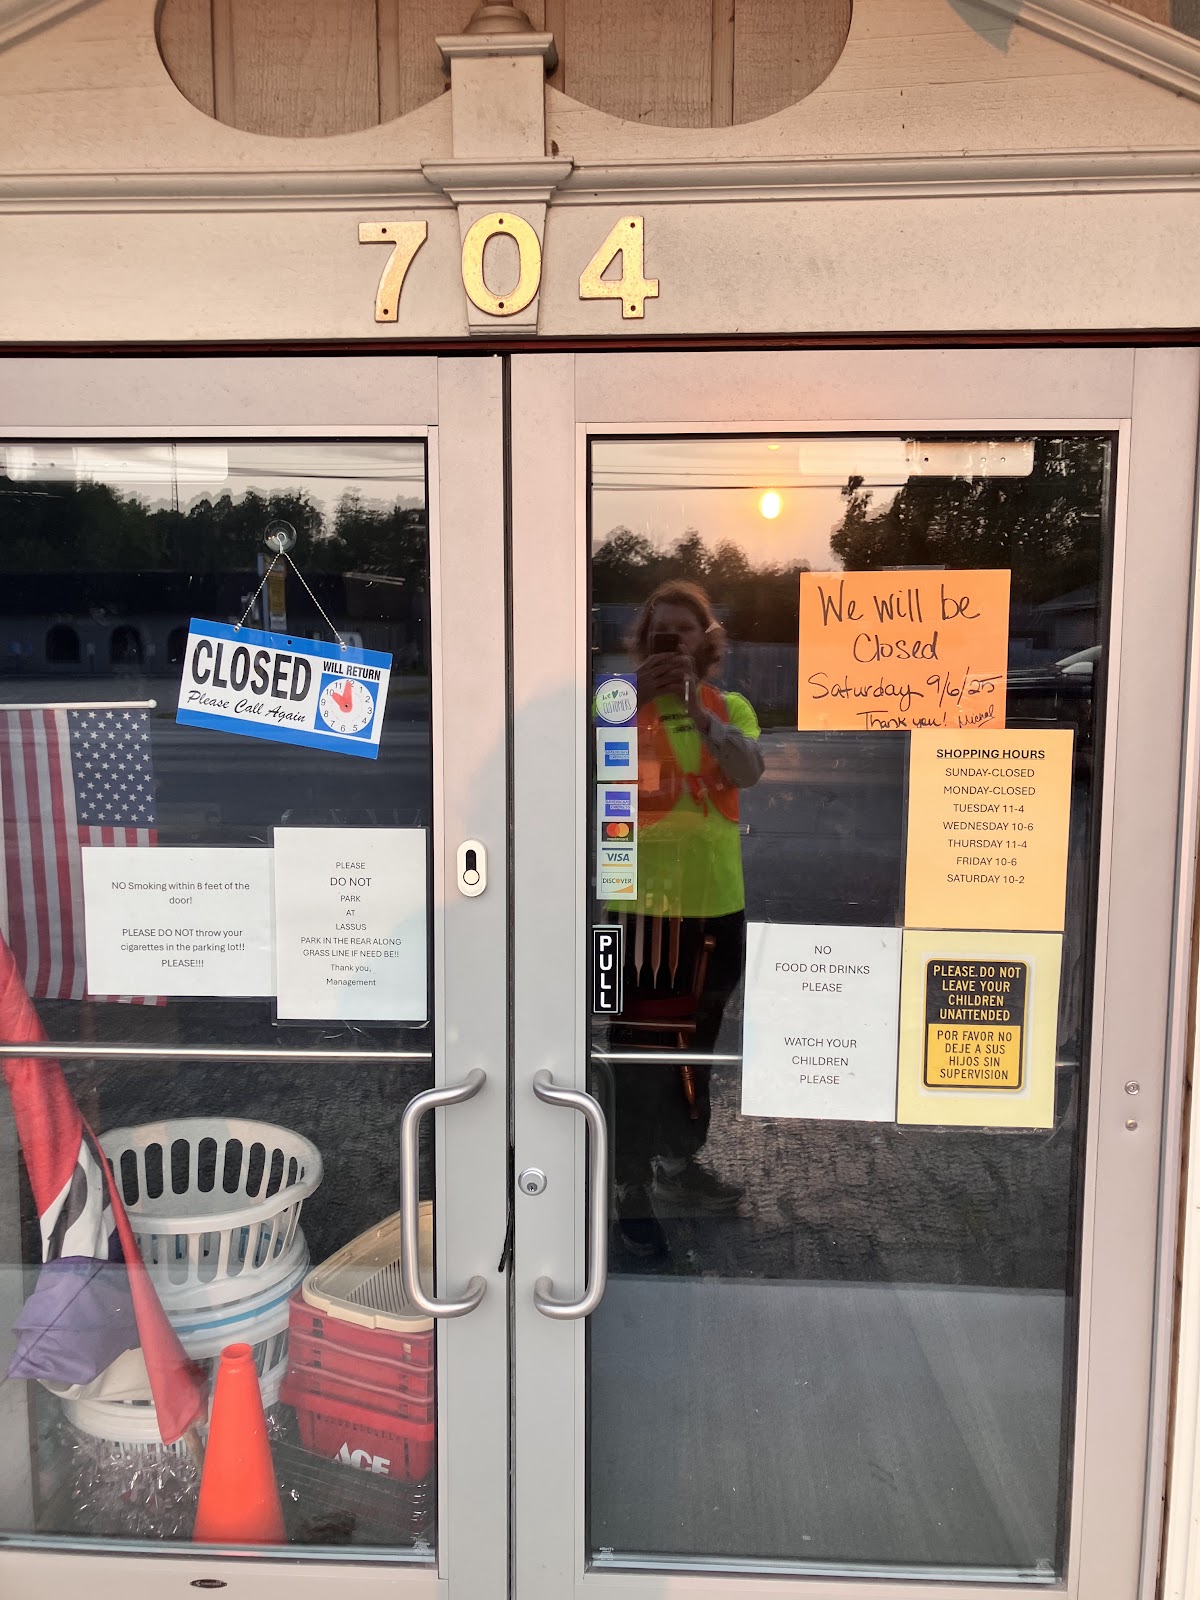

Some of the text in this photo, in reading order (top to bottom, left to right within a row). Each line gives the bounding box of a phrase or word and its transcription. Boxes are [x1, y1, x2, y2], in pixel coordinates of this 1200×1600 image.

[358, 211, 660, 323] 704
[817, 580, 864, 626] We
[941, 584, 980, 620] be
[853, 631, 939, 663] Closed
[192, 640, 312, 702] CLOSED
[324, 661, 381, 680] WILL RETURN
[808, 666, 1002, 712] Saturday 9/6/25
[187, 690, 306, 723] Please Call Again
[856, 710, 907, 730] Thank
[912, 711, 947, 729] you!
[936, 749, 1045, 759] SHOPPING HOURS
[945, 768, 1035, 778] SUNDAY-CLOSED
[944, 786, 1036, 796] MONDAY-CLOSED
[954, 804, 1024, 813] TUESDAY 11-4
[943, 821, 1034, 831] WEDNESDAY 10-6
[948, 839, 1003, 848] THURSDAY
[606, 853, 629, 861] VISA
[957, 857, 1017, 866] FRIDAY 10-6
[330, 878, 372, 886] DO NOT
[947, 874, 1025, 884] SATURDAY 10-2
[112, 882, 250, 892] NO Smoking within 8 feet of the
[122, 929, 243, 938] PLEASE DO NOT throw your
[121, 943, 245, 953] cigarettes in the parking lot!!
[814, 946, 832, 954] NO
[162, 959, 204, 967] PLEASE!!!
[600, 935, 613, 1008] PULL
[775, 963, 870, 974] FOOD OR DRINKS
[980, 966, 995, 977] DO
[1000, 967, 1021, 978] NOT
[802, 983, 842, 992] PLEASE
[942, 980, 1010, 992] LEAVE YOUR
[948, 995, 1004, 1006] CHILDREN
[940, 1009, 1010, 1021] UNATTENDED
[937, 1030, 1012, 1042] POR FAVOR NO
[785, 1037, 857, 1048] WATCH YOUR
[945, 1044, 1005, 1054] DEJE A SUS
[792, 1056, 849, 1066] CHILDREN
[949, 1057, 1000, 1067] HIJOS SIN
[940, 1069, 1008, 1079] SUPERVISION
[800, 1075, 840, 1084] PLEASE
